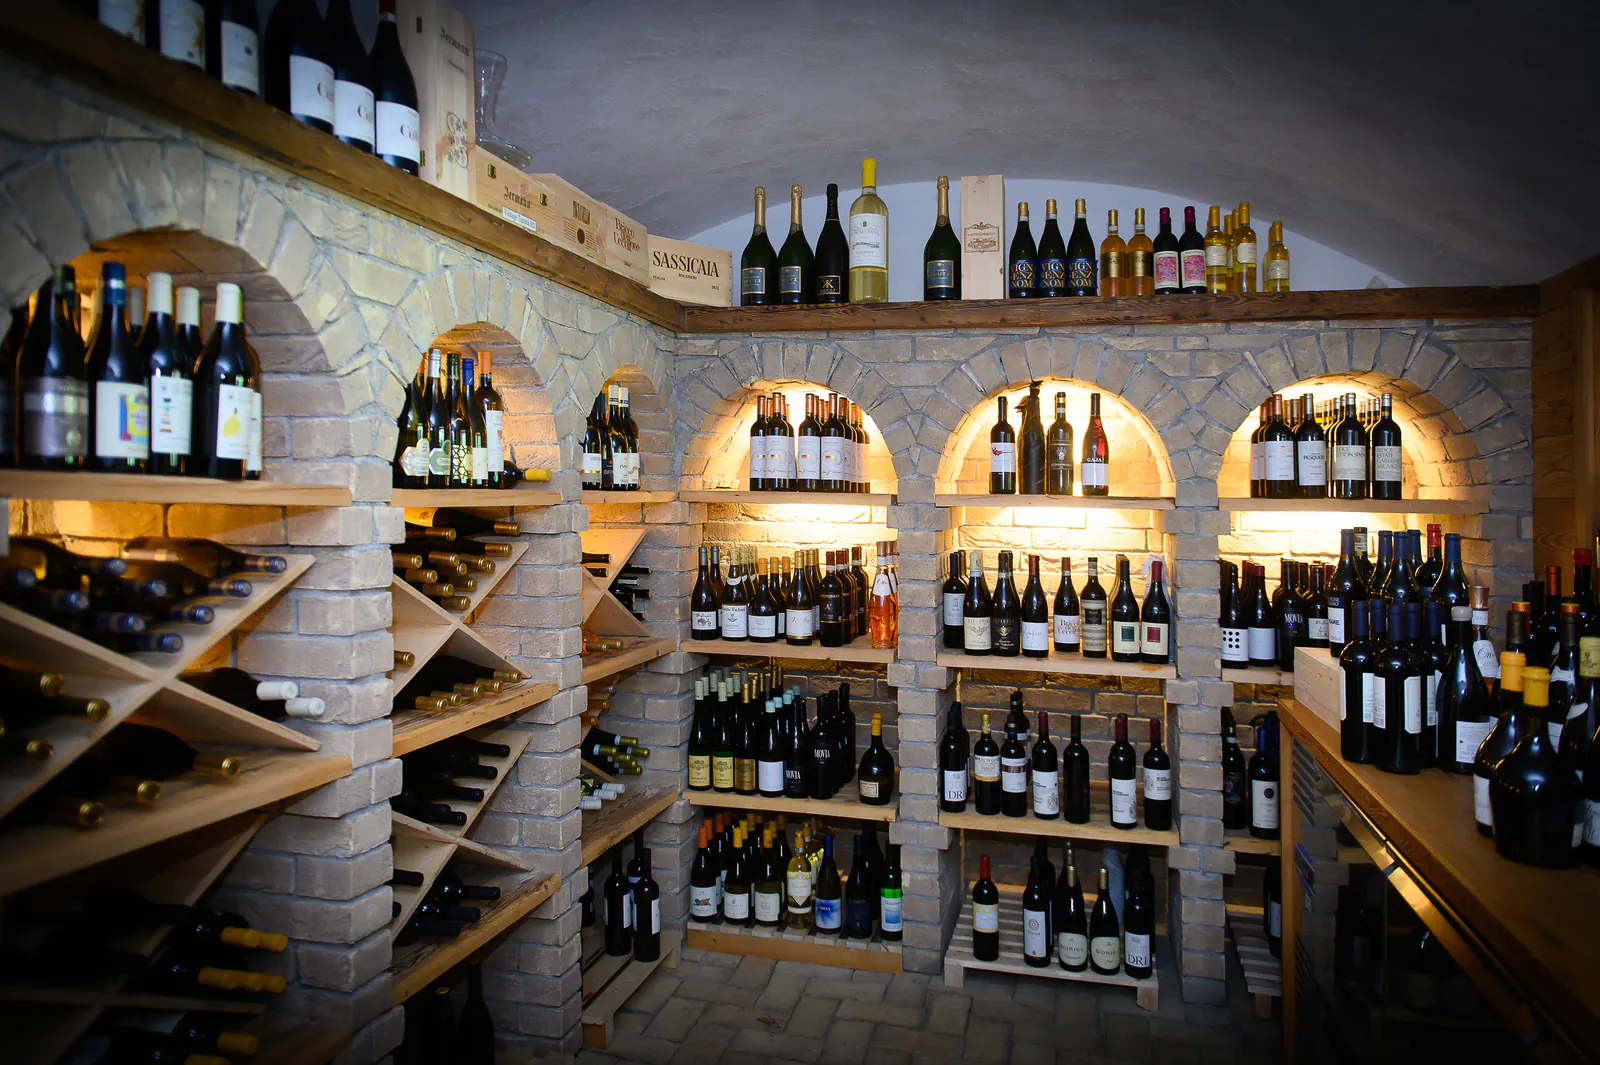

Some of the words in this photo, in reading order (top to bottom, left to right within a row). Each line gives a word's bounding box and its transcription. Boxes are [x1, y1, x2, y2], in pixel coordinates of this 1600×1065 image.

[652, 250, 719, 278] SASSICAIA
[1284, 613, 1303, 624] MOVIA
[814, 749, 831, 758] MOVIA
[785, 769, 801, 780] MOVIA
